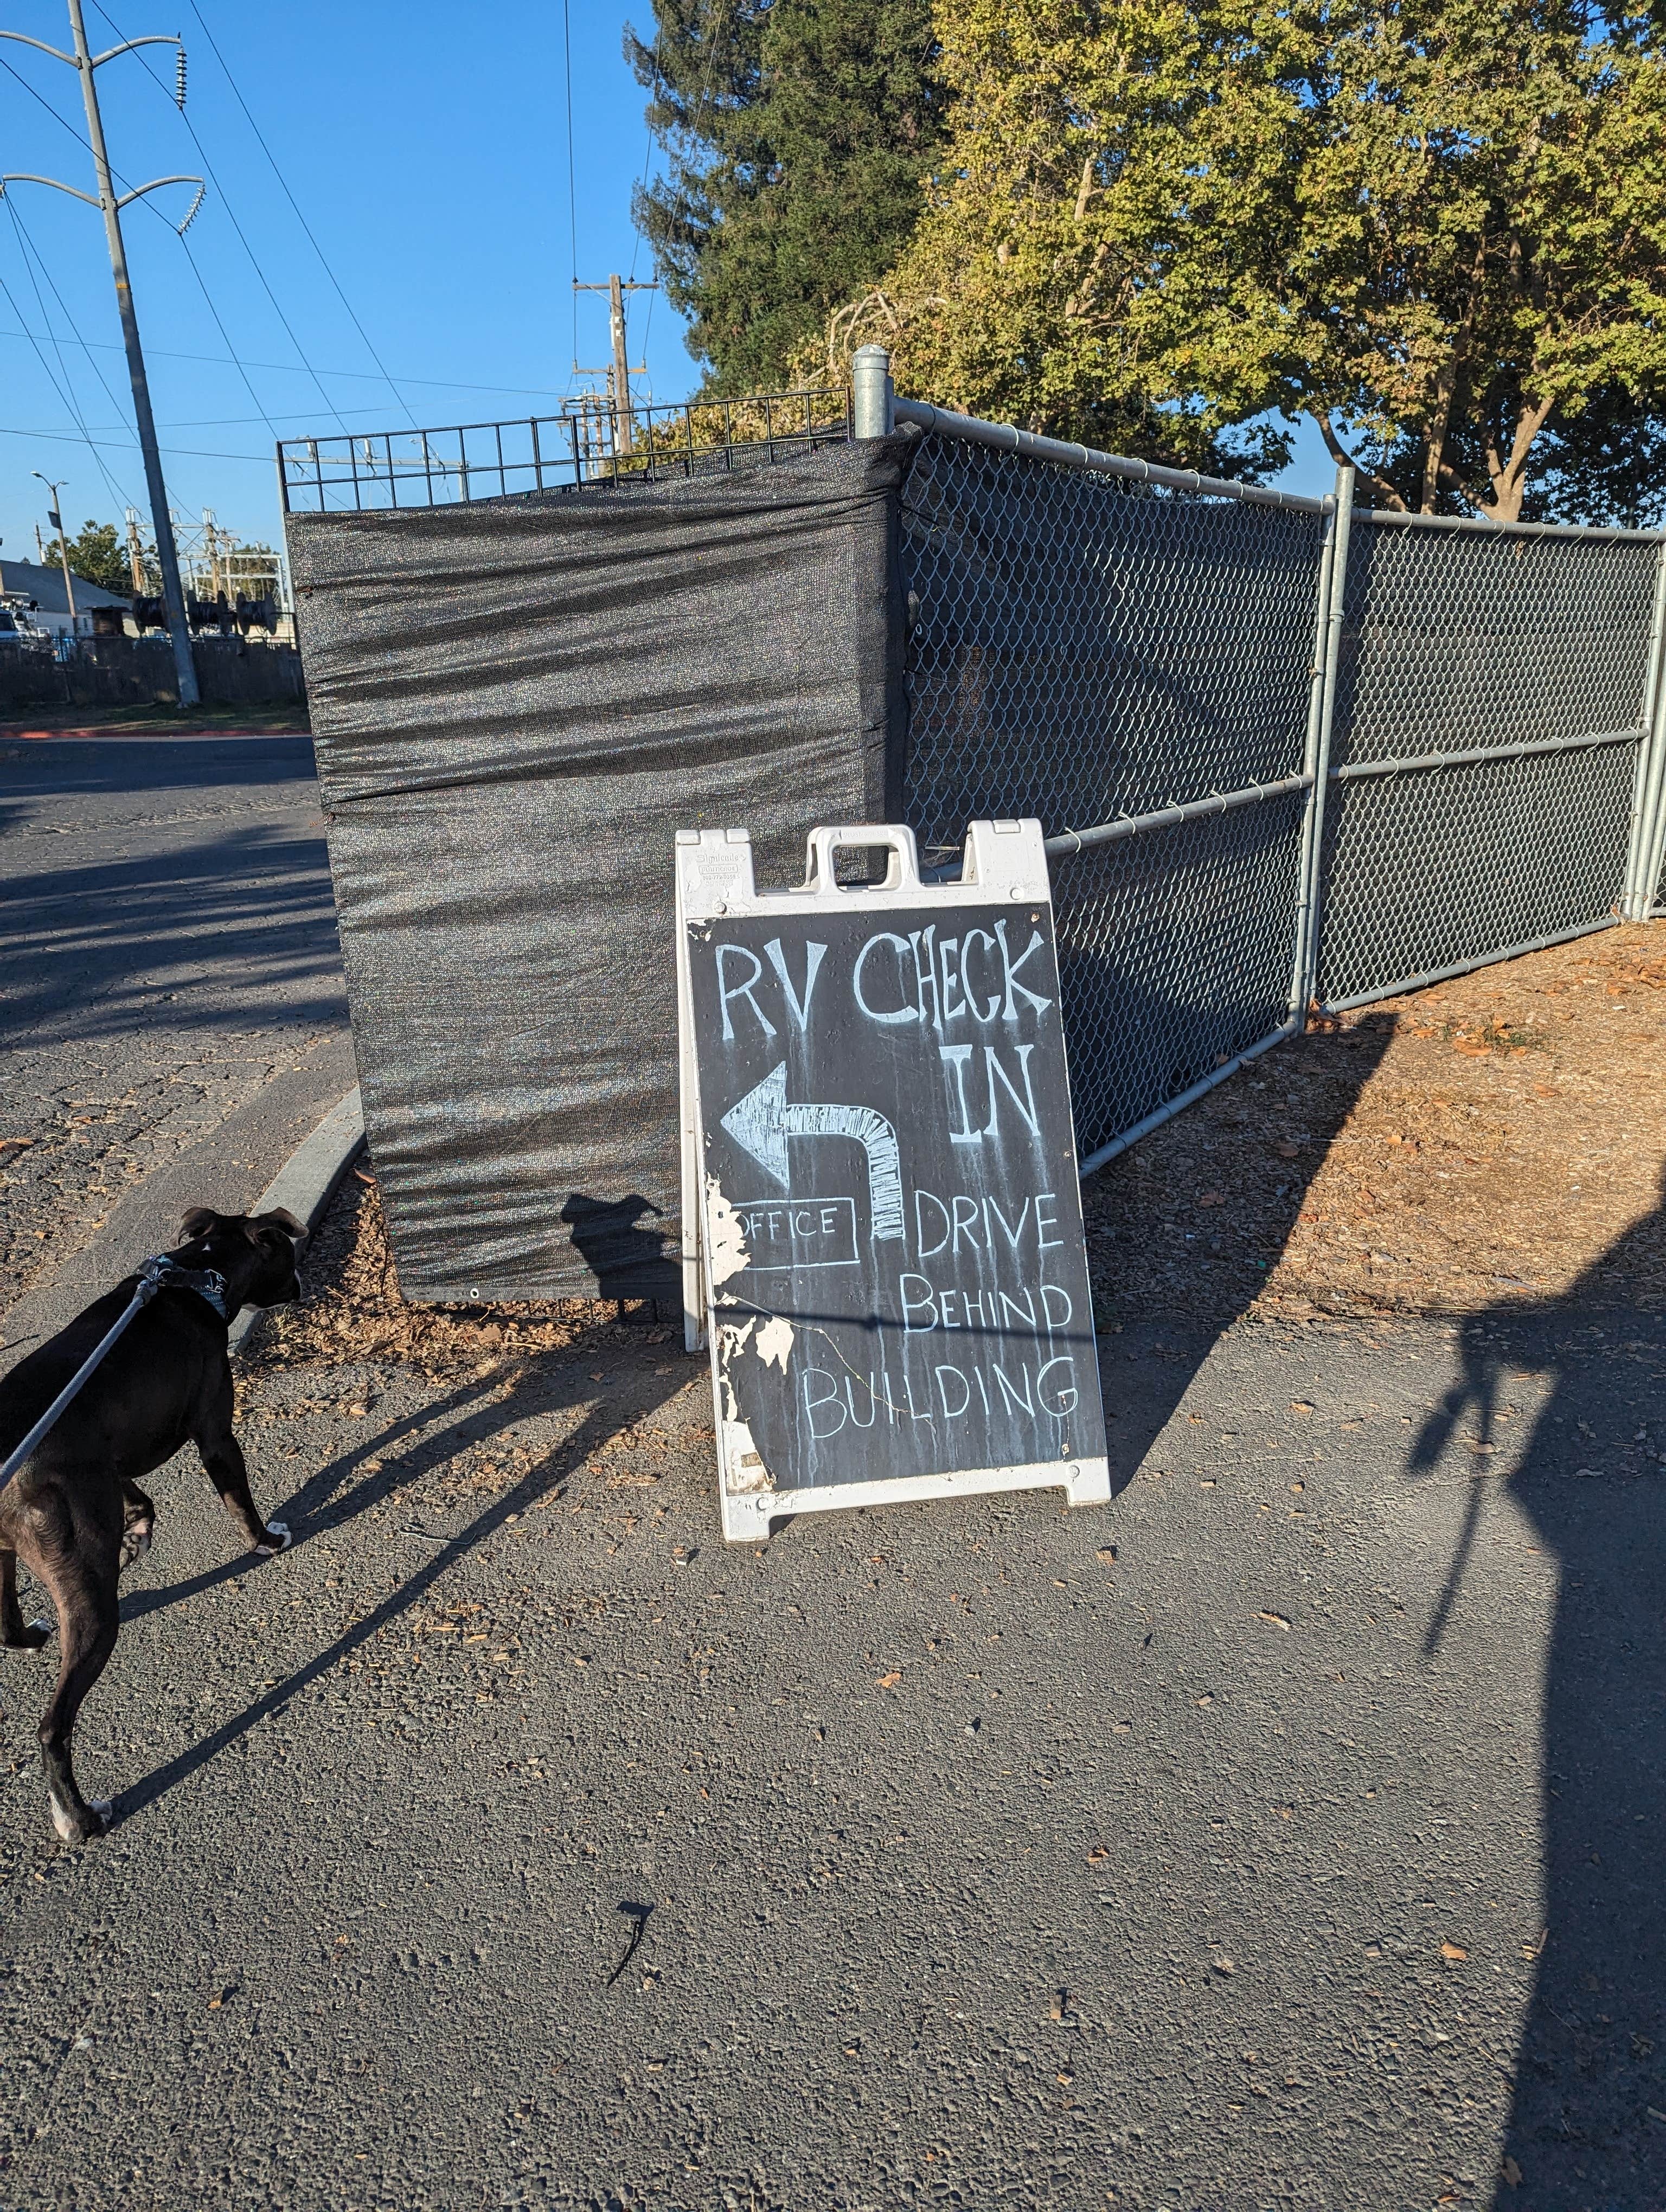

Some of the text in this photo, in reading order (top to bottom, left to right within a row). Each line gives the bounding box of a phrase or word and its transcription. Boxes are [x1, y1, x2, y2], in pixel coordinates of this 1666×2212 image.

[715, 918, 1053, 1039] RV CHECK
[939, 1044, 1040, 1143] IN
[915, 1190, 1063, 1257] DRIVE
[900, 1274, 1072, 1333] BEHIND
[802, 1357, 1078, 1438] BUILDING
